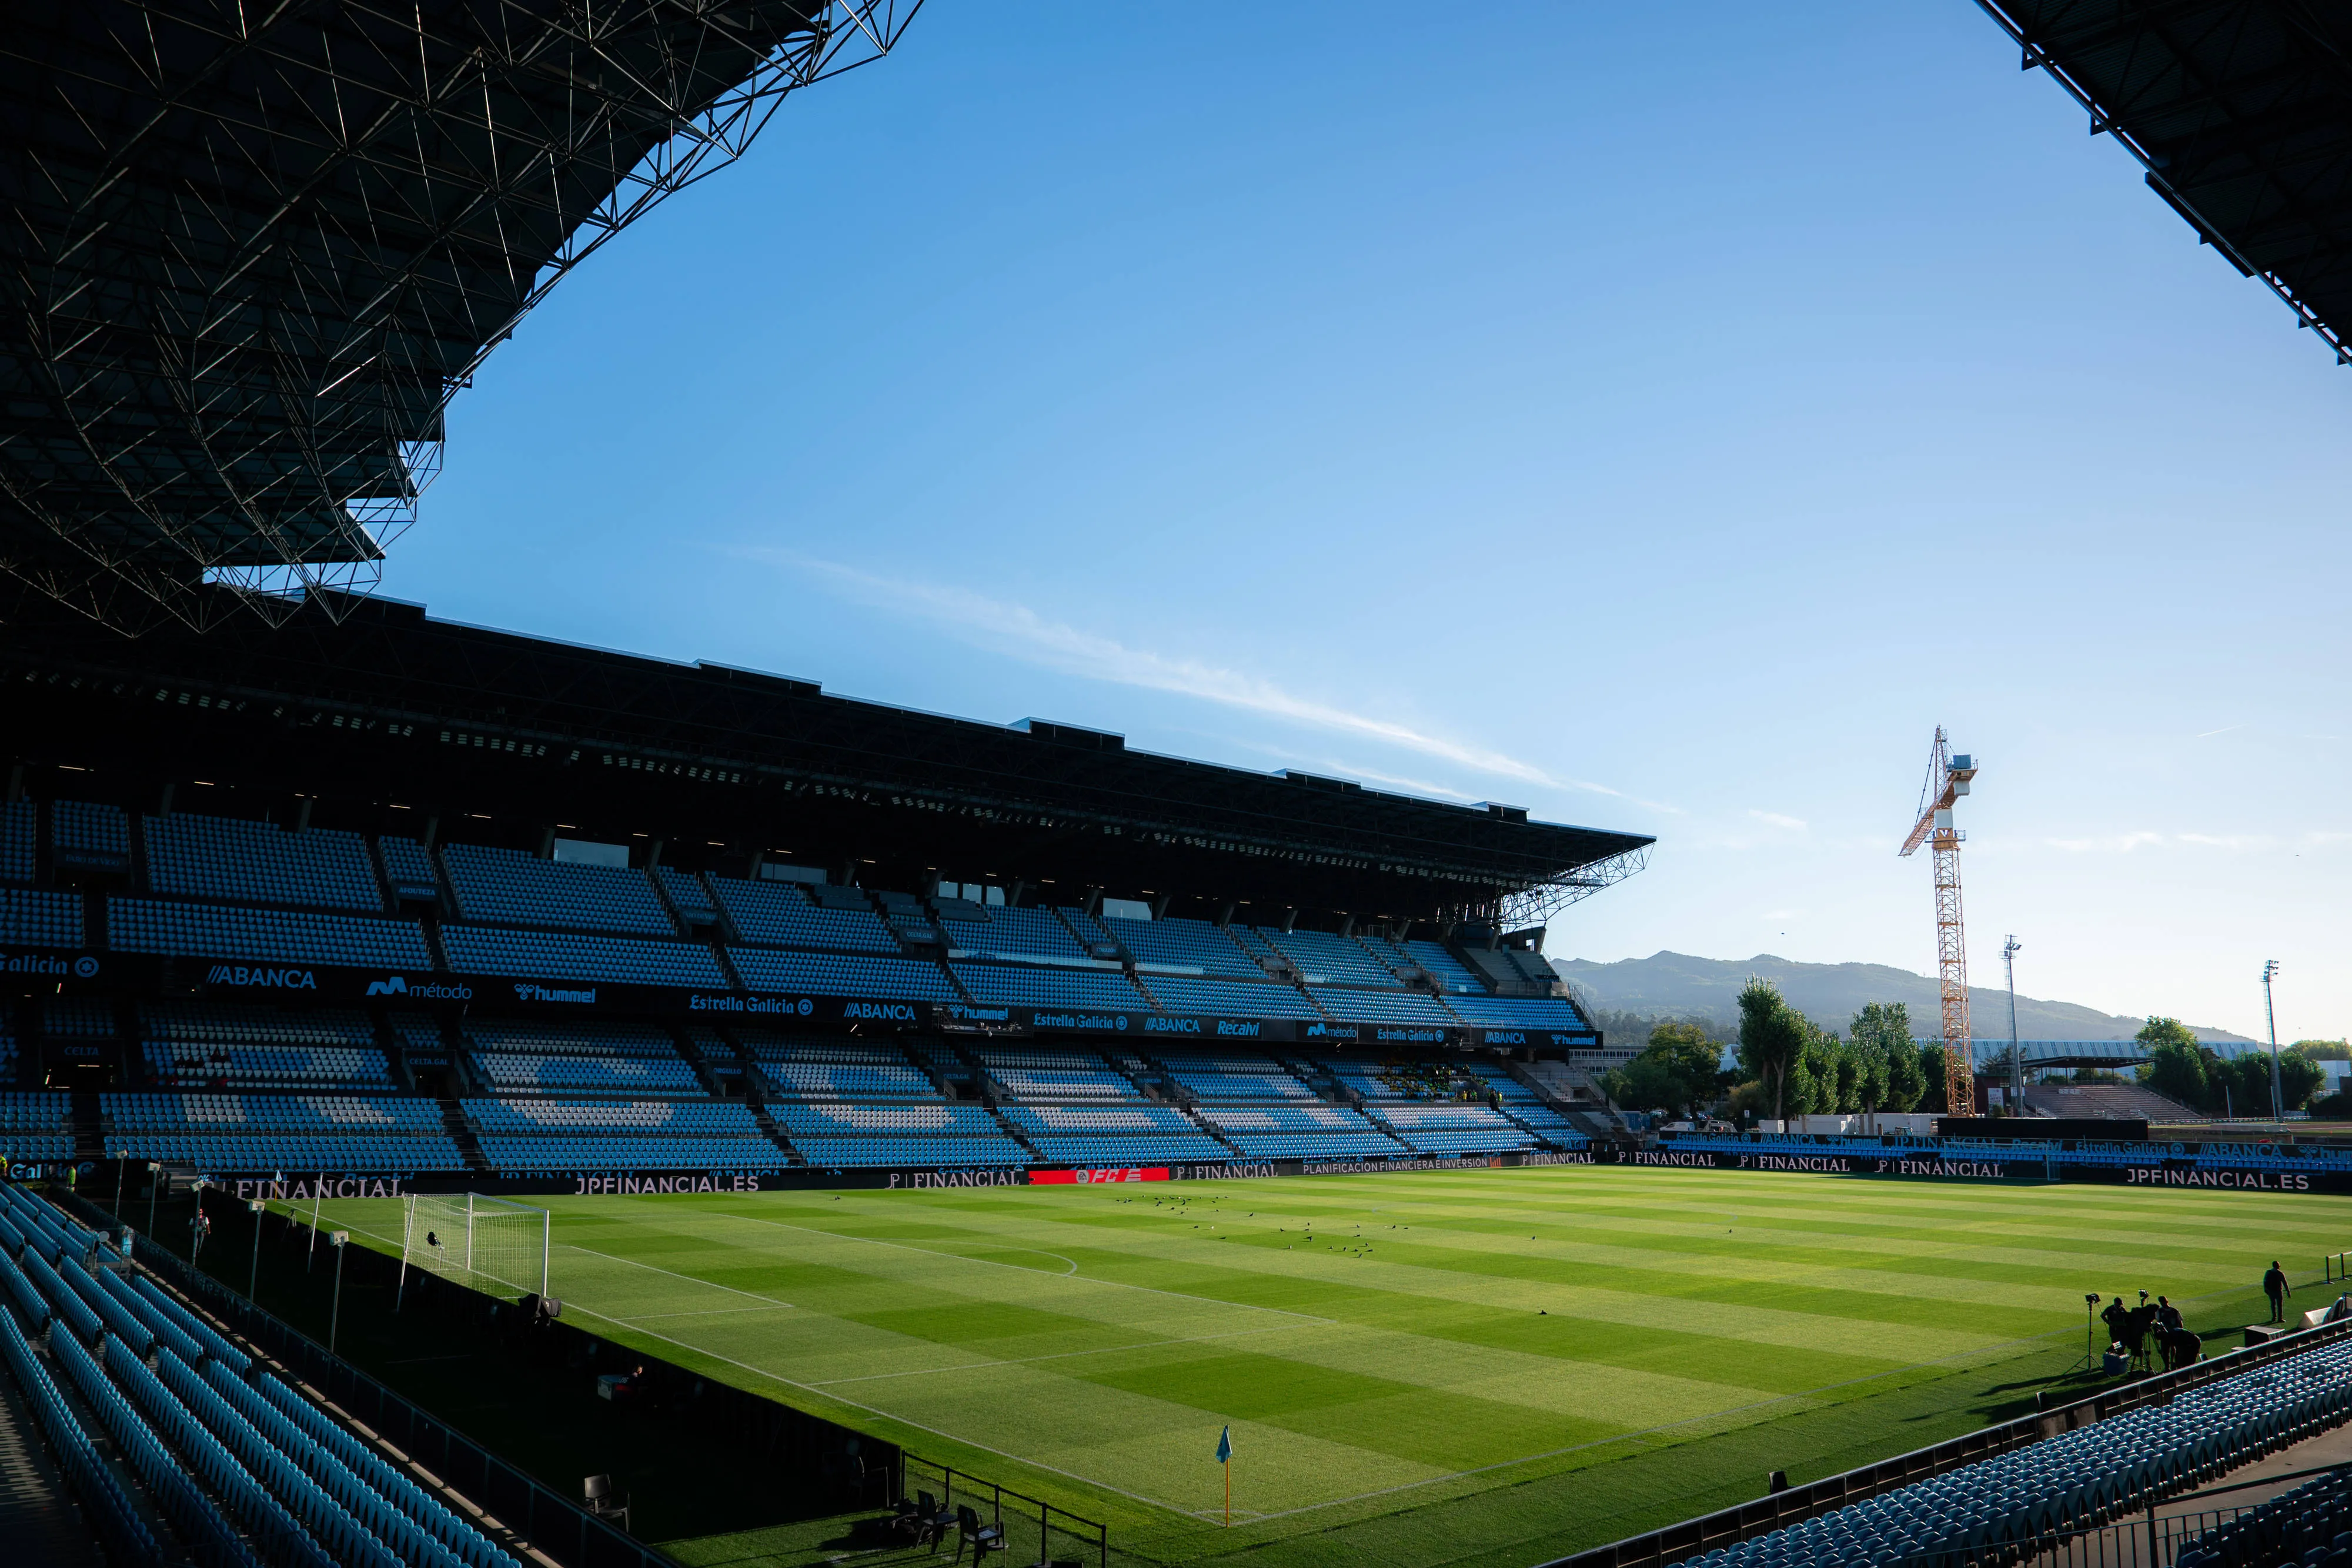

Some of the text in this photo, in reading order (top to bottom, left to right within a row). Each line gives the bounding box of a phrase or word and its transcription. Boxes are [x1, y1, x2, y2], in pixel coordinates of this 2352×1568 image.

[410, 981, 472, 999] método
[535, 985, 596, 1004] hummel
[689, 994, 794, 1015] Estrella Galicia
[964, 1006, 1008, 1021] hummel
[1034, 1012, 1114, 1029] Estrella Galicia
[1217, 1020, 1260, 1037] Recalvi
[1327, 1024, 1357, 1038] método
[1377, 1028, 1434, 1042] Estrella Galicia
[1561, 1035, 1596, 1046] hummel
[64, 1046, 100, 1057] CELTA
[409, 1058, 449, 1066] CELTA.GAL
[1303, 1156, 1487, 1175] PLANIFICACIÓN FINANCIERA E INVERSIÓN
[1535, 1152, 1595, 1165] FINANCIAL
[1635, 1152, 1716, 1166] FINANCIAL
[1759, 1156, 1850, 1172] FINANCIAL
[1195, 1164, 1278, 1179] FINANCIAL
[1900, 1161, 2004, 1178] FINANCIAL
[574, 1175, 759, 1195] JPFINANCIAL.ES
[913, 1171, 1020, 1189] FINANCIAL
[2127, 1168, 2310, 1191] JPFINANCIAL.ES
[236, 1178, 404, 1200] FINANCIAL
